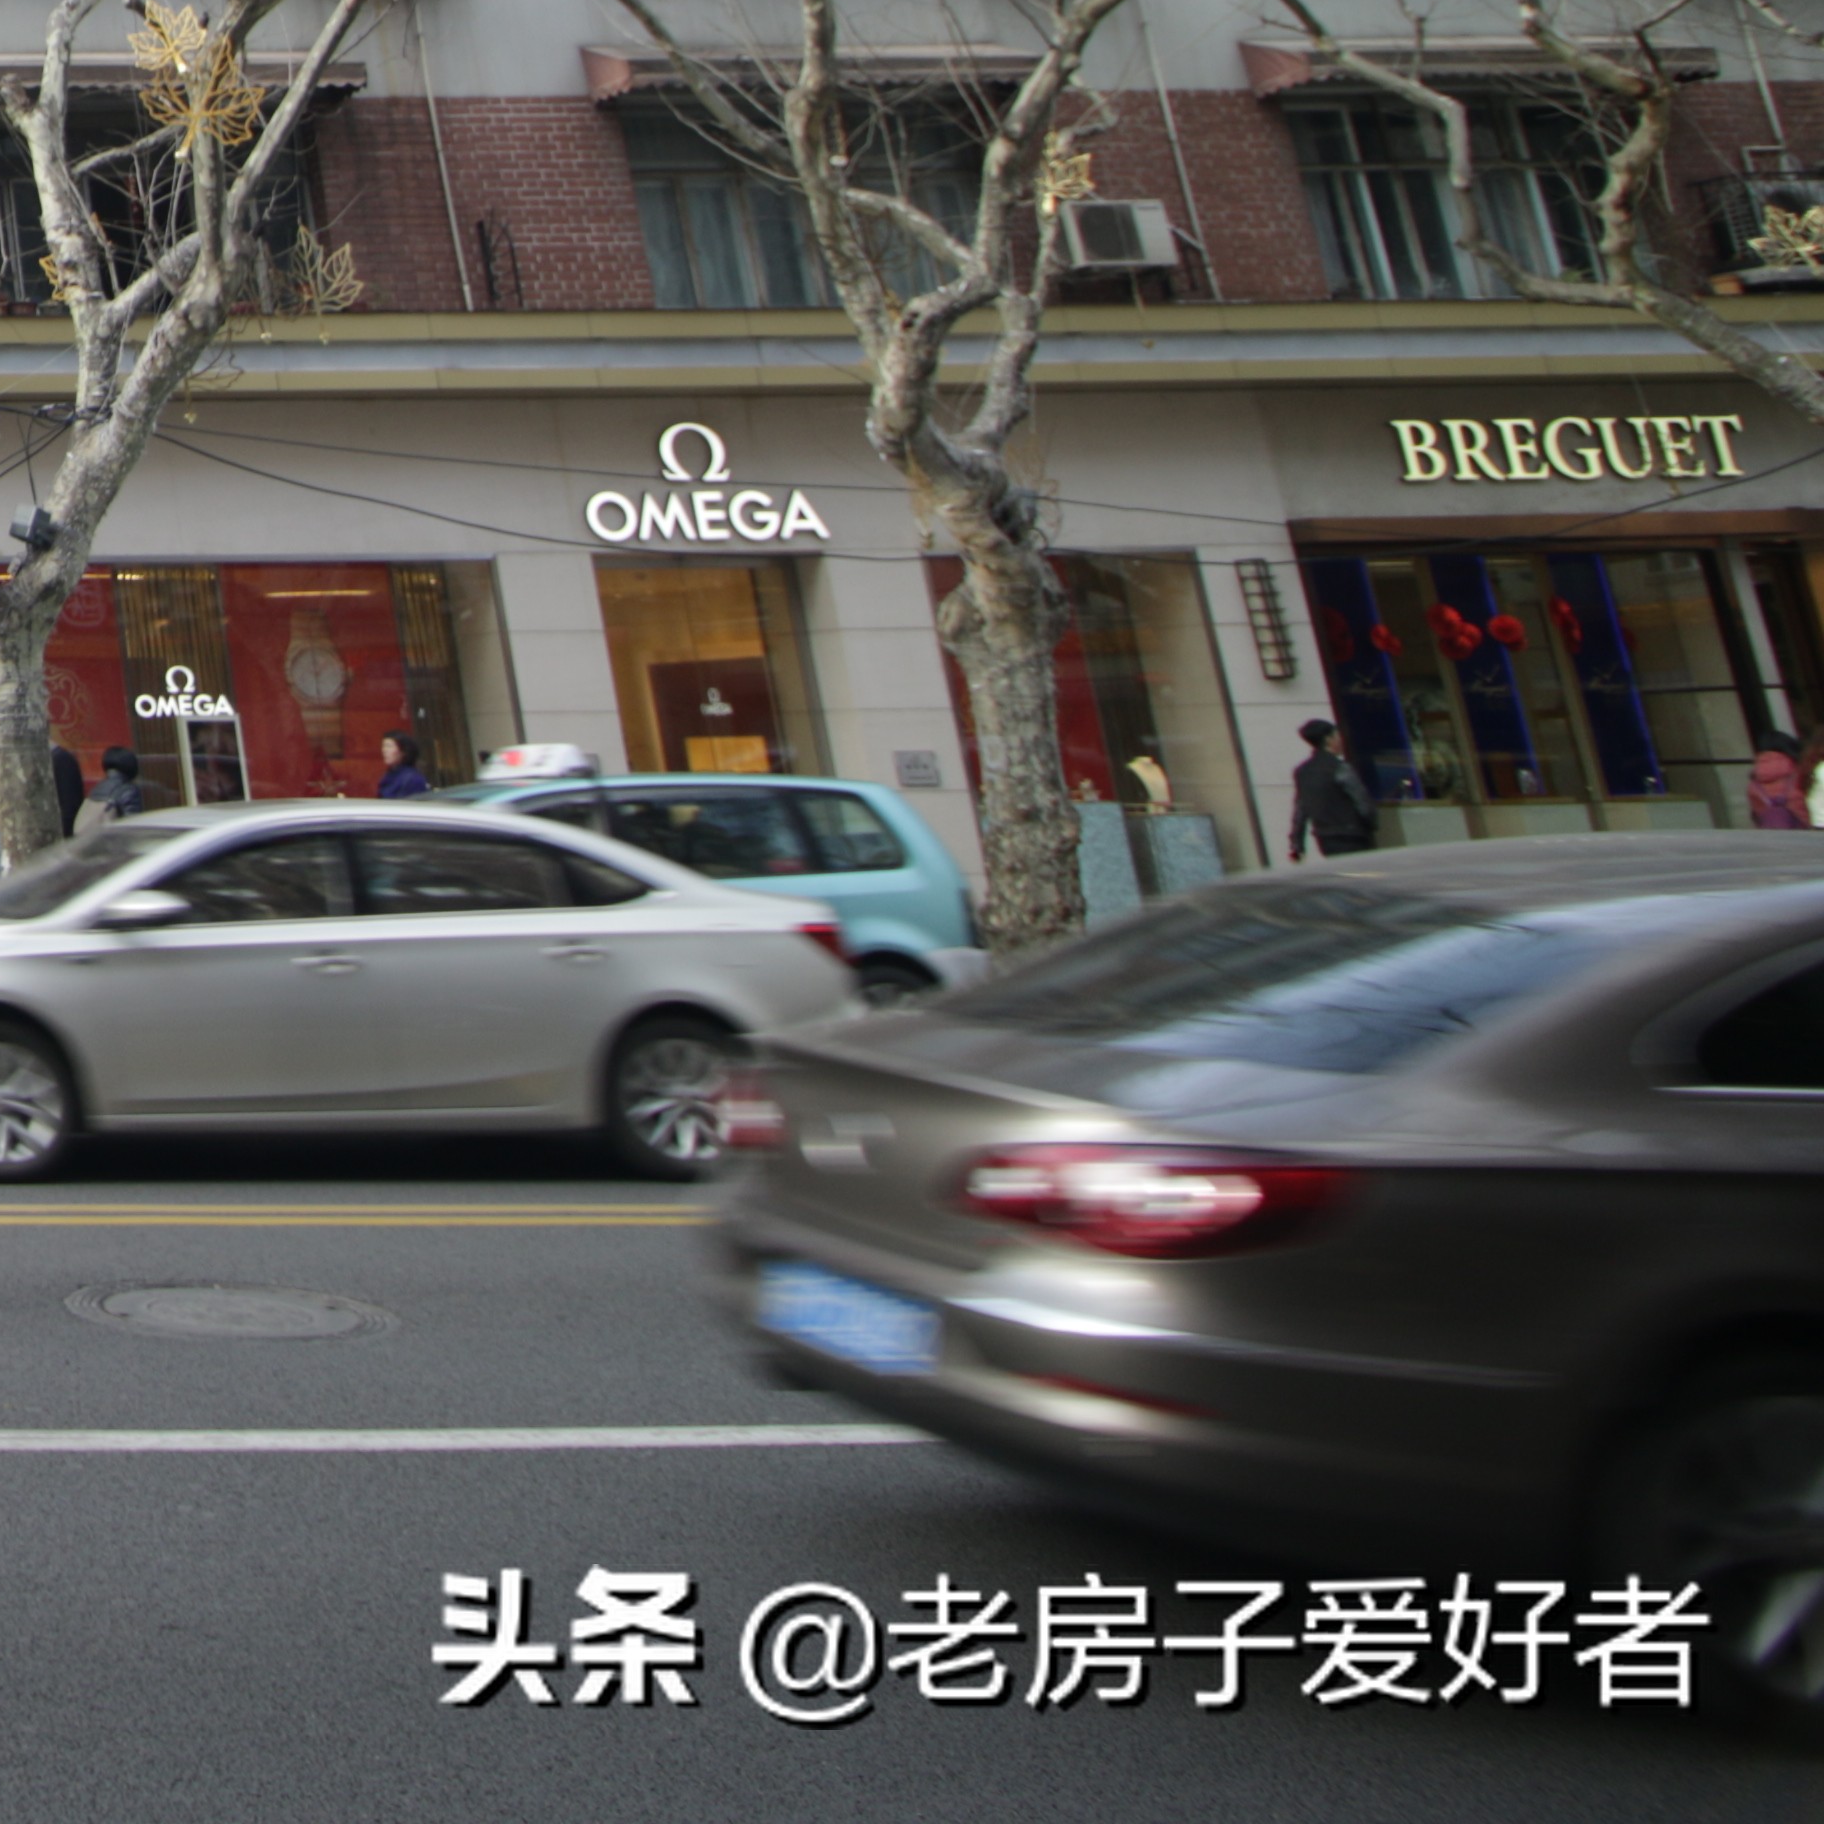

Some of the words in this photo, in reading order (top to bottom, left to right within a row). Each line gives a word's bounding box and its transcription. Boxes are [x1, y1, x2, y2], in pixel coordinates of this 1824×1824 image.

[1389, 413, 1744, 481] BREGUET
[585, 489, 832, 543] OMEGA
[134, 693, 235, 719] OMEGA
